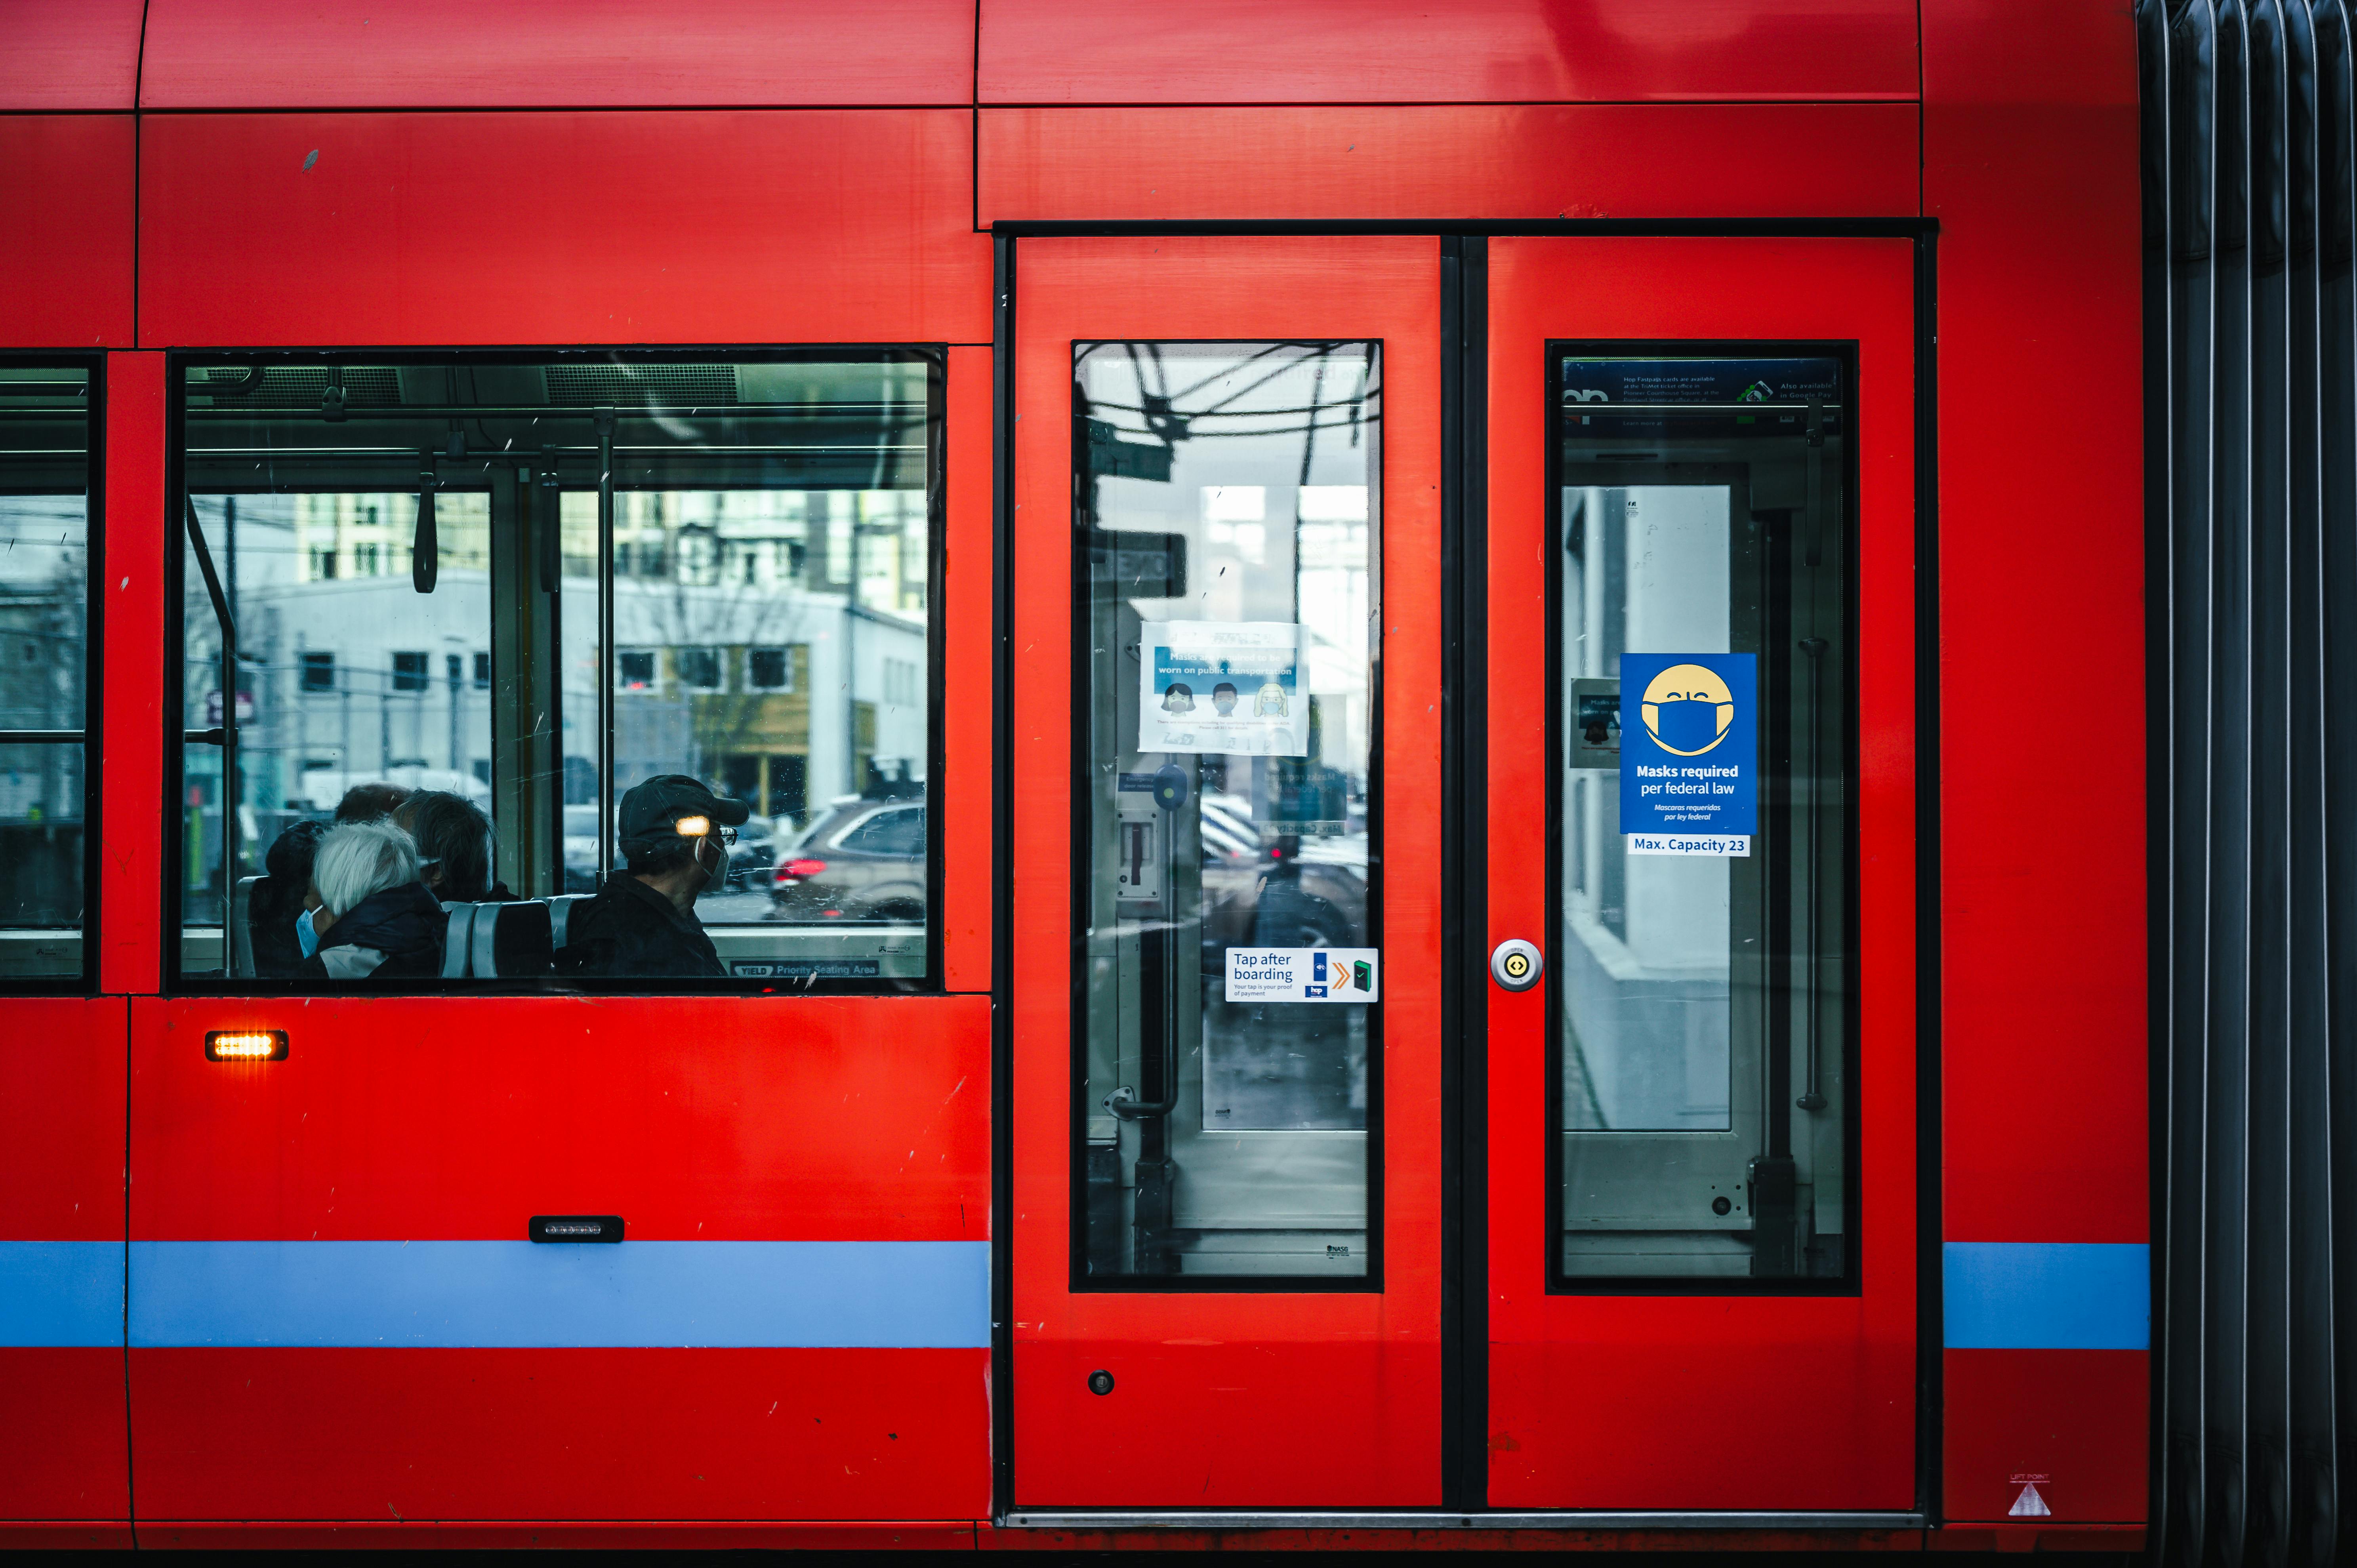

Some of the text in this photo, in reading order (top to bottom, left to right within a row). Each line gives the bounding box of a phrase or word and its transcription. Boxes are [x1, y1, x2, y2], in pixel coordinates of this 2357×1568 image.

[1170, 653, 1198, 661] Masks
[1216, 654, 1255, 663] required
[1269, 653, 1281, 662] be
[1198, 667, 1224, 676] public
[1227, 667, 1292, 676] transportation
[1637, 765, 1739, 780] Masks required
[1641, 782, 1735, 797] per federal law
[1635, 838, 1745, 854] Max. Capacity 23
[1234, 953, 1291, 967] Tap after
[777, 966, 876, 975] Priority Seating Area
[1235, 968, 1293, 983] boarding
